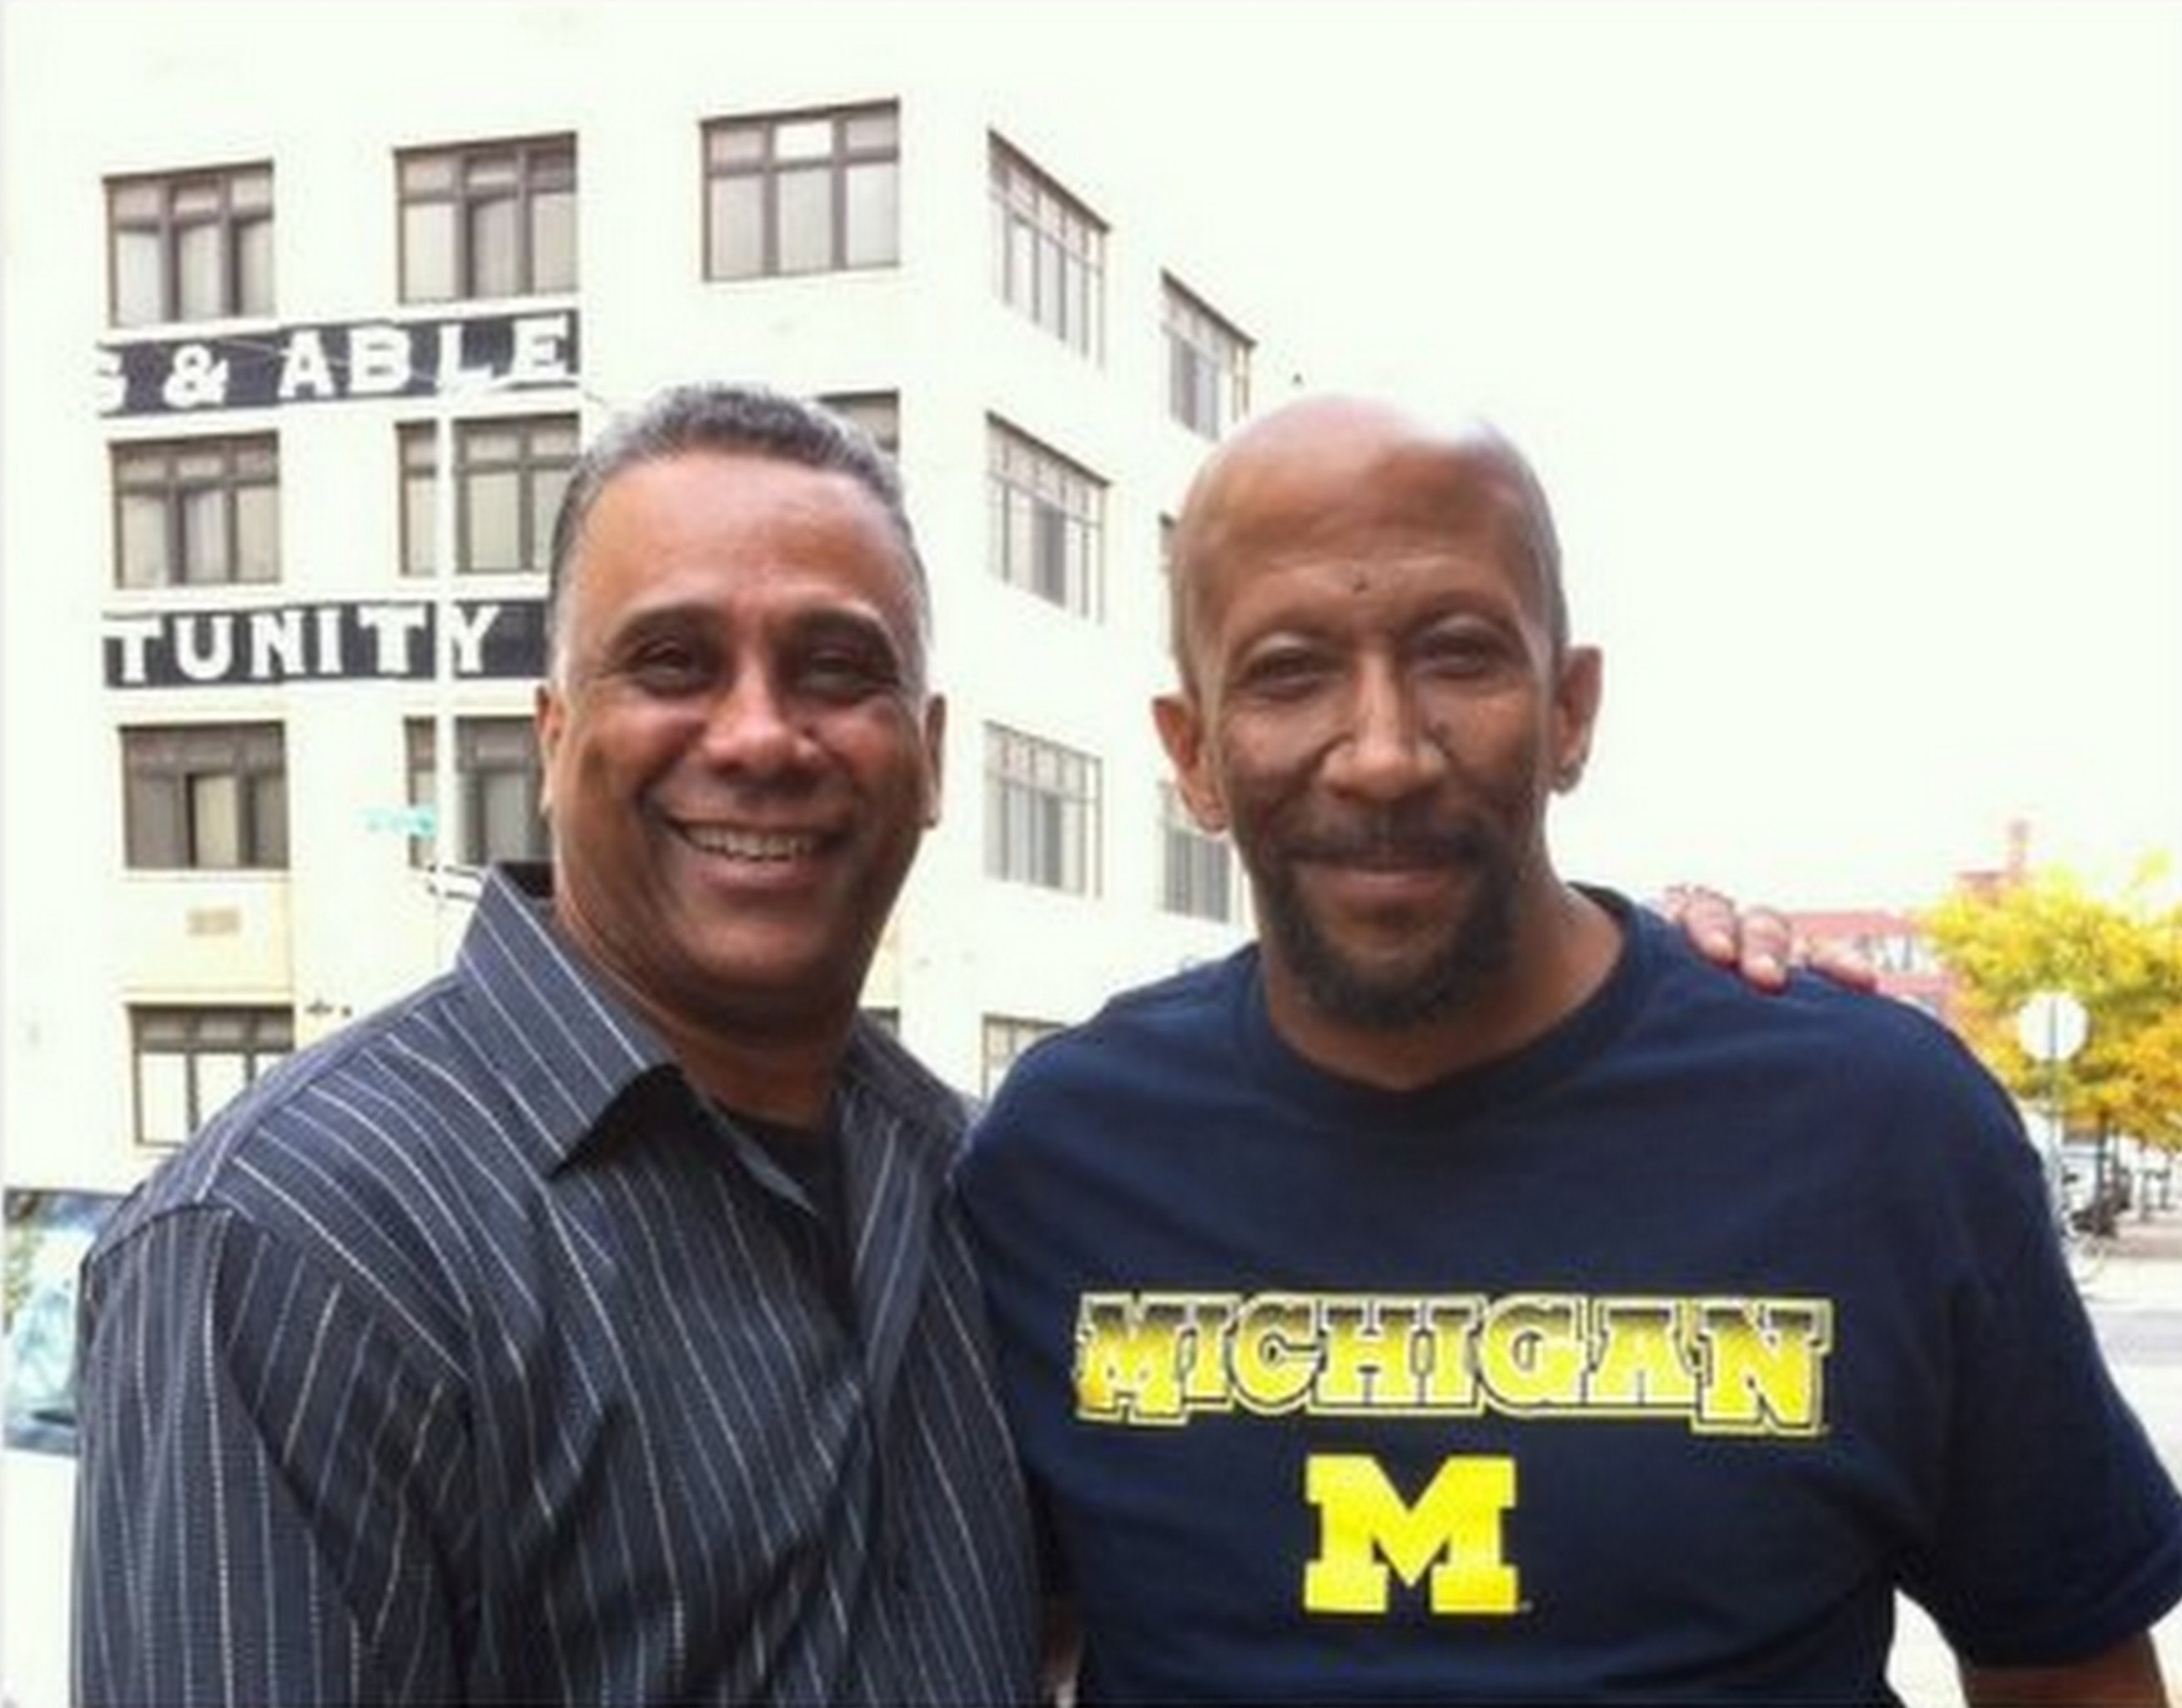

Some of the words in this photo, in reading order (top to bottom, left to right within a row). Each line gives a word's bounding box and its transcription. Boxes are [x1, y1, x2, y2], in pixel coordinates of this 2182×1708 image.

[163, 344, 229, 409] &
[277, 314, 568, 399] ABLE
[102, 604, 500, 684] TUNITY
[1074, 1293, 1834, 1436] MICHIGAN
[1304, 1454, 1518, 1613] M
